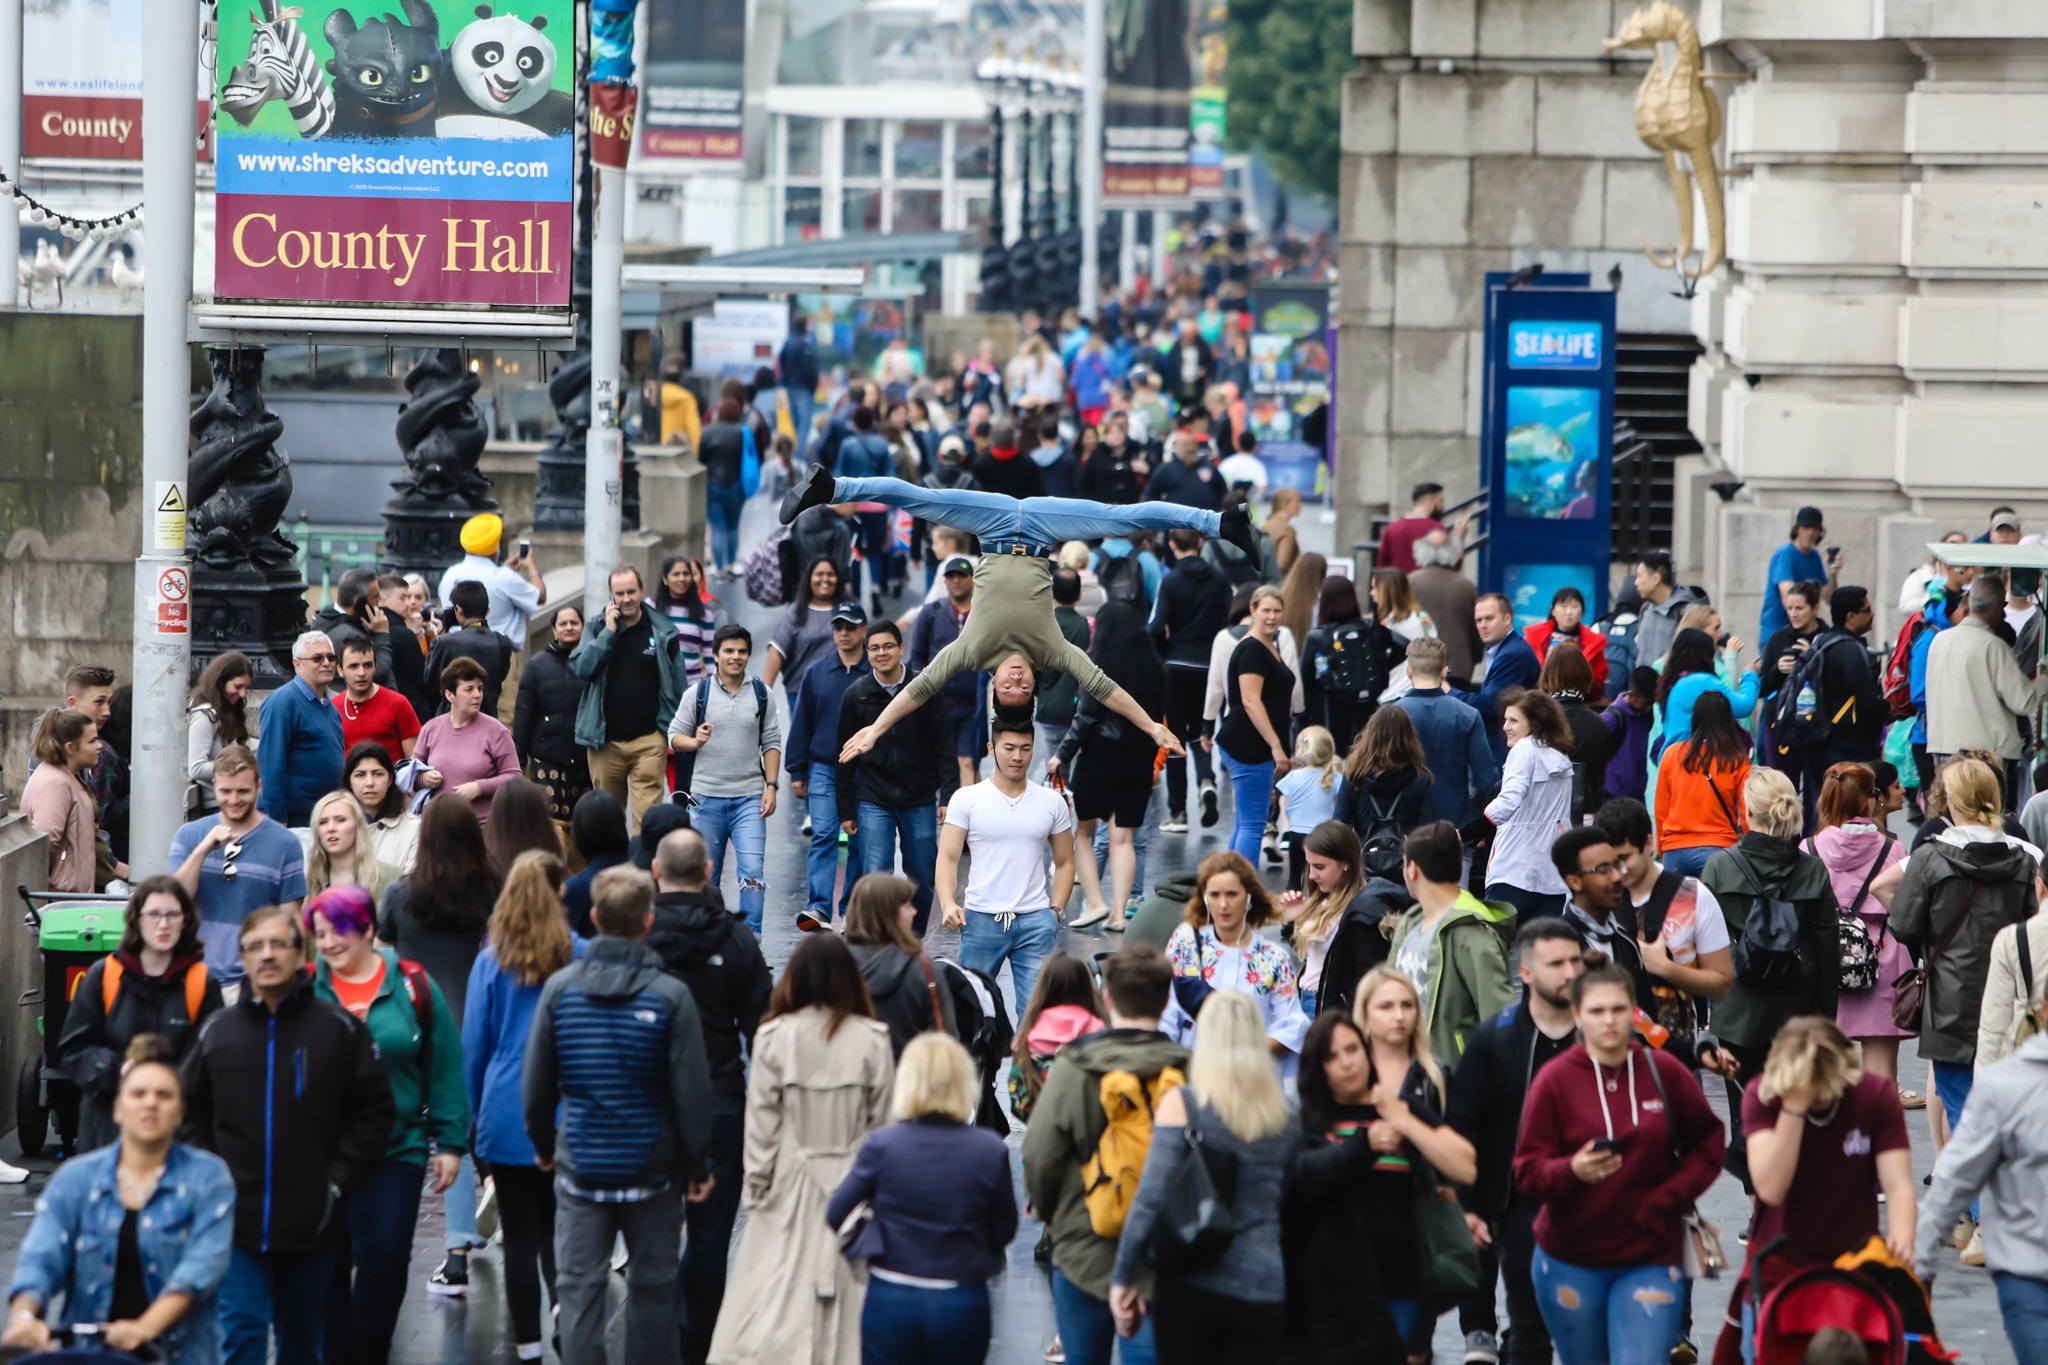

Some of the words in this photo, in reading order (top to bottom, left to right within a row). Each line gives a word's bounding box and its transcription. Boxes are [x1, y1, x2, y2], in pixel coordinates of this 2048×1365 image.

[35, 78, 144, 92] www.sealifelond
[41, 111, 133, 144] County
[238, 153, 549, 178] www.shreksadventure.com
[232, 213, 427, 286] County
[441, 218, 554, 274] Hall
[1515, 330, 1553, 357] SEA
[158, 618, 187, 628] cycling
[168, 608, 181, 617] No
